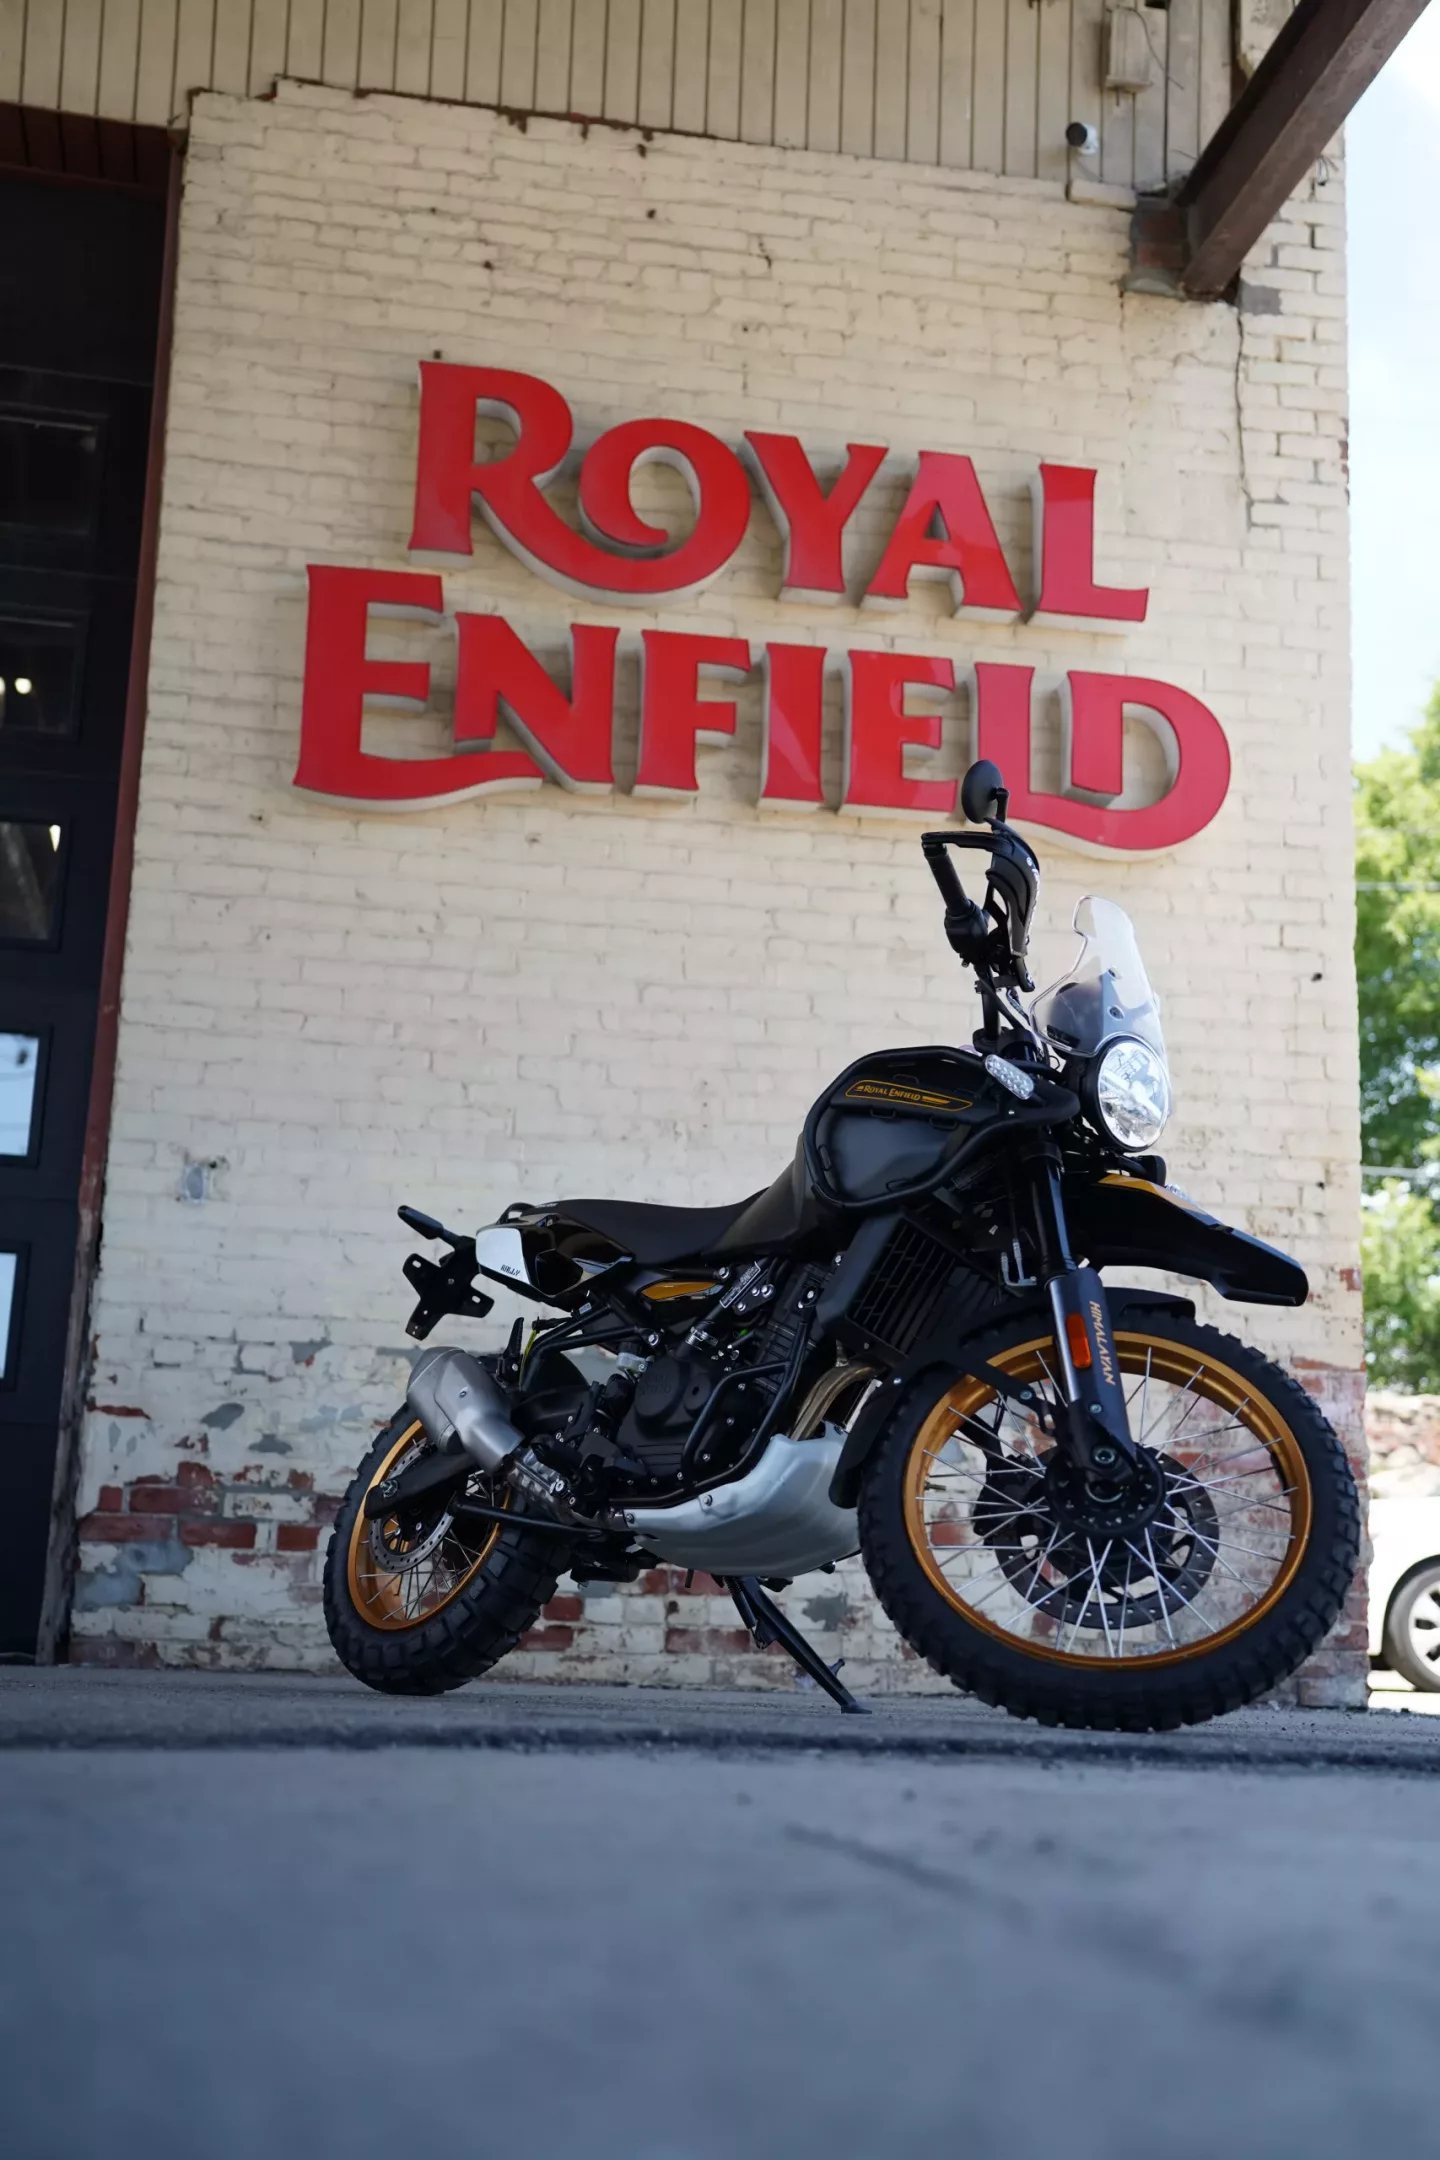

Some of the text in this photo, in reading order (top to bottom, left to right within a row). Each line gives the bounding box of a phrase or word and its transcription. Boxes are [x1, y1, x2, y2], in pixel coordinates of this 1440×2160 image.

[409, 360, 1149, 626] ROYAL
[293, 563, 1231, 853] ENFIELD
[864, 1085, 920, 1100] ROYAL ENFIELD
[1088, 1300, 1116, 1387] HIMALAYAN
